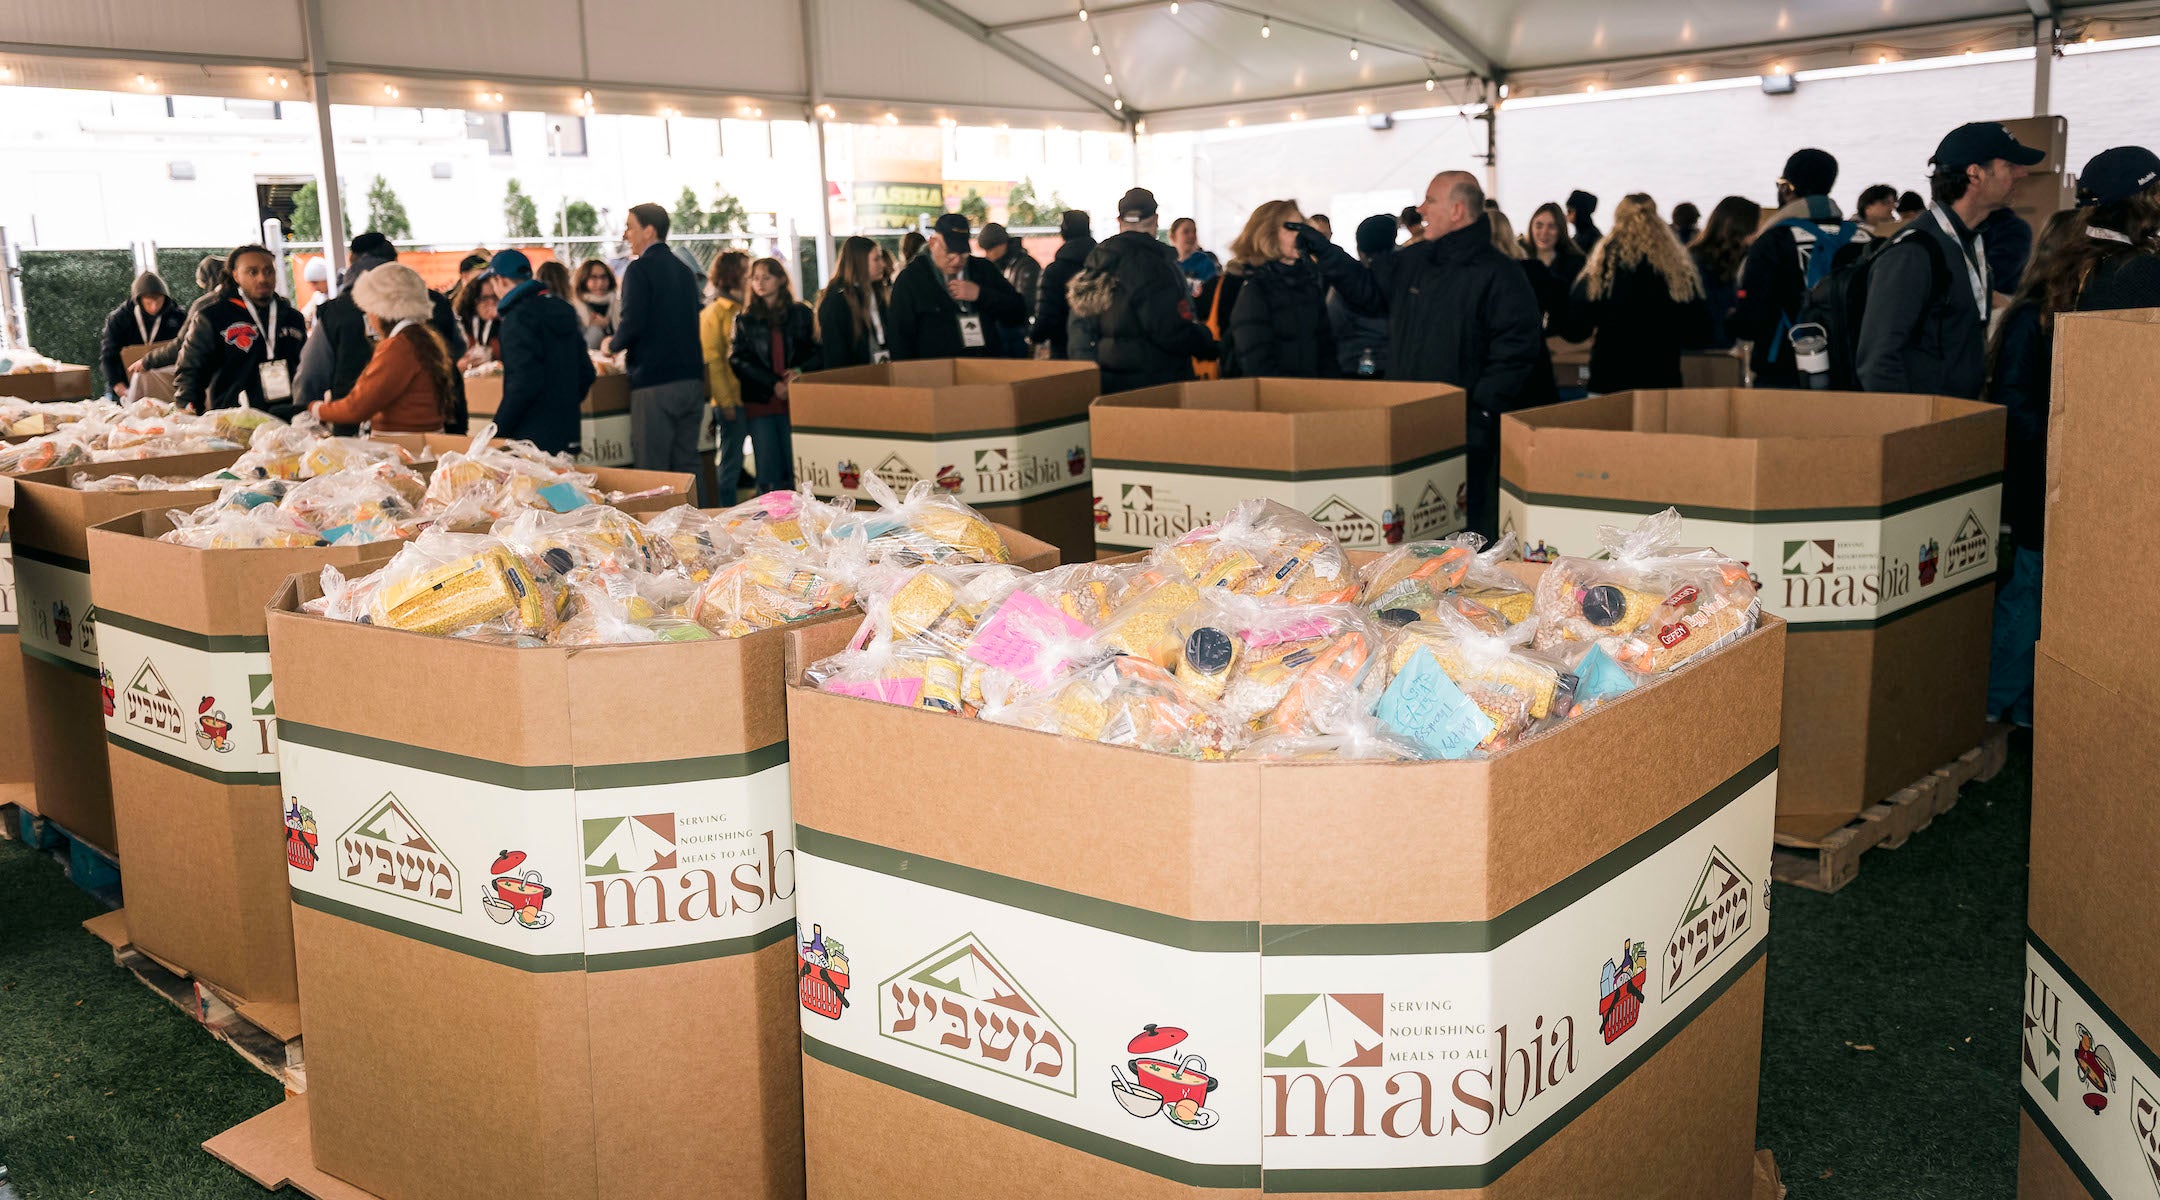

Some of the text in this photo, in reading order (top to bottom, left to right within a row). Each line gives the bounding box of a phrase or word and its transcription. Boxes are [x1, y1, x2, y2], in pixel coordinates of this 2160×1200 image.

[977, 456, 1062, 494] masbia
[1784, 549, 1911, 609] masbia
[1661, 624, 1687, 645] GEFEN
[679, 813, 728, 826] SERVING
[680, 829, 754, 845] NOURISHING
[681, 847, 758, 864] MEALS TO ALL
[1389, 1000, 1453, 1012] SERVING
[1389, 1024, 1486, 1037] NOURISHING
[1389, 1049, 1489, 1062] MEALS TO ALL
[1264, 1015, 1579, 1139] masbia
